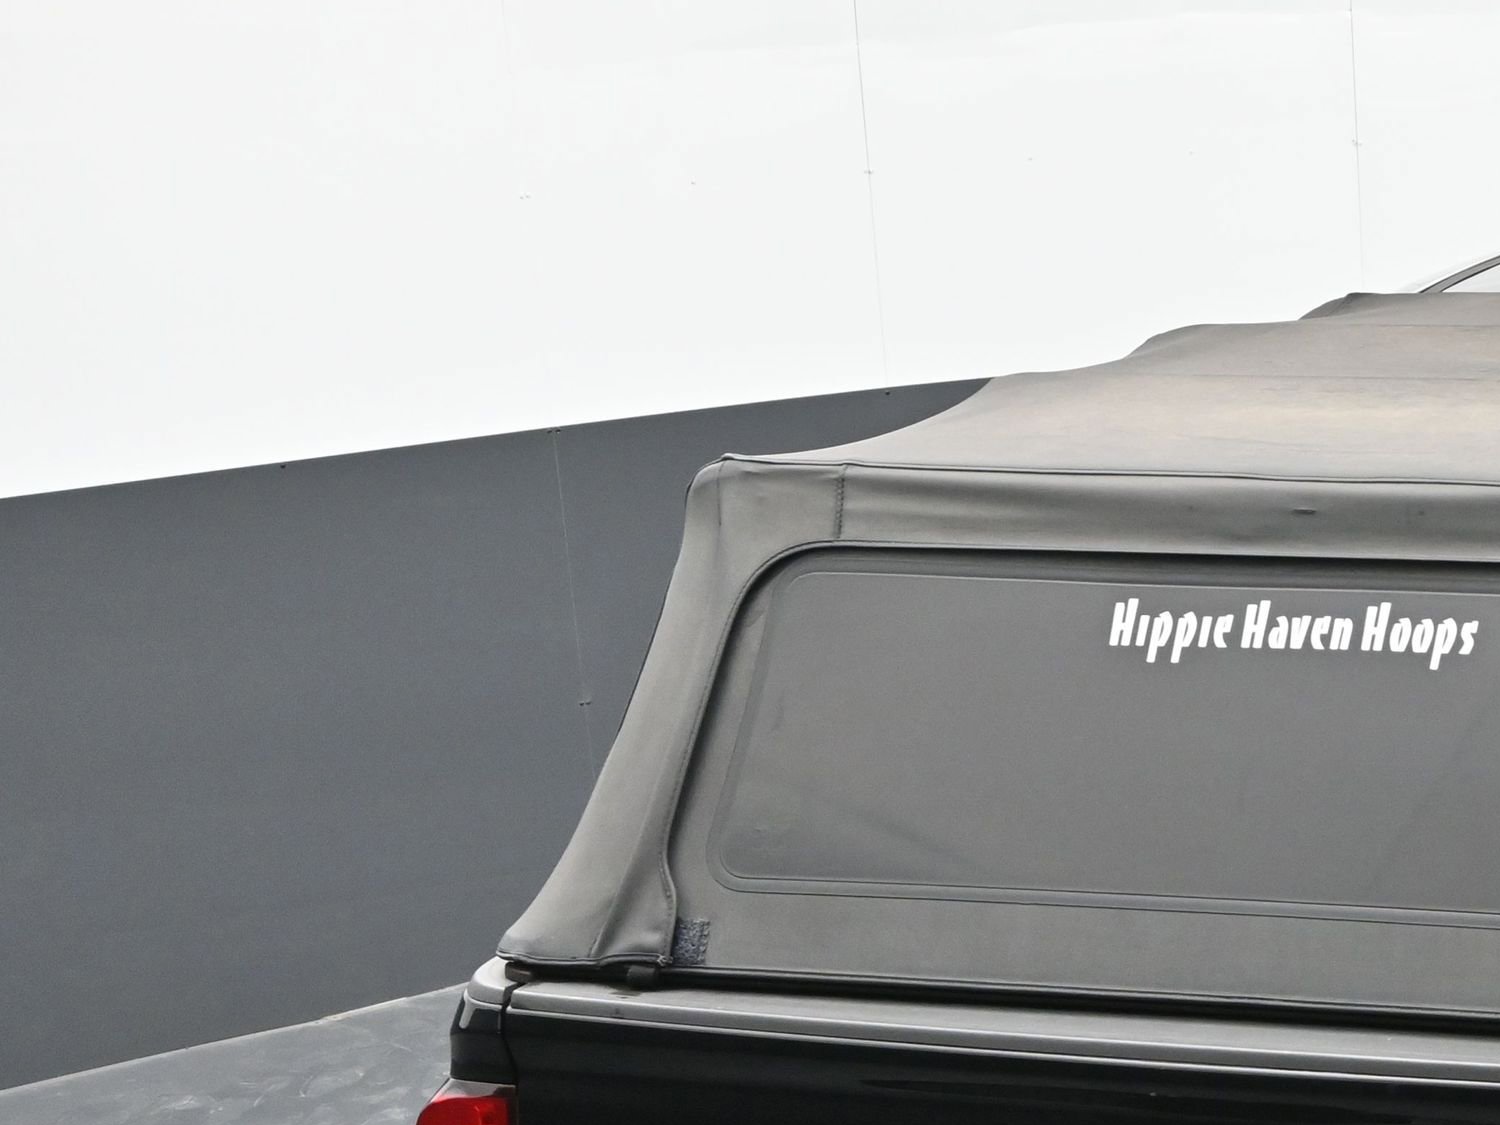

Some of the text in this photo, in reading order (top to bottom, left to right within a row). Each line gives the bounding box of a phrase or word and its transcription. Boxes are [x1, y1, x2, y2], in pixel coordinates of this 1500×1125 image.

[1109, 598, 1479, 671] Hippie Haven Hoops
